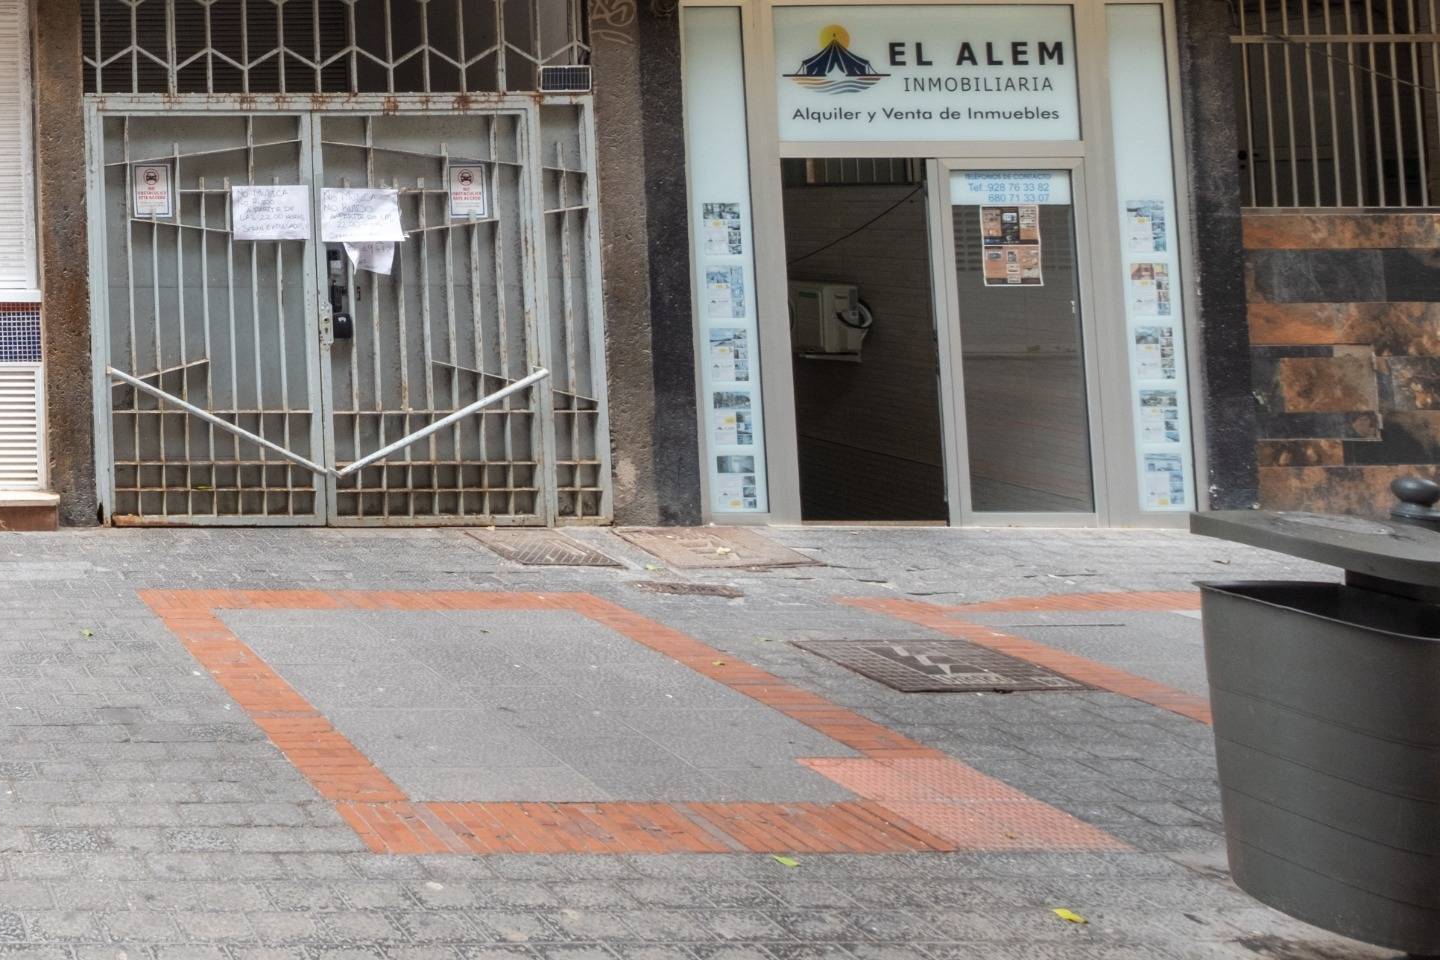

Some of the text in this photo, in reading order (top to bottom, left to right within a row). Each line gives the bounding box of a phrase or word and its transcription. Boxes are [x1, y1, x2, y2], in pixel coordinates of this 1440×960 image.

[889, 41, 1064, 66] EL ALEM
[903, 77, 1054, 92] INMOBILIARIA
[792, 106, 1061, 123] Alquiler y Venta de Inmuebles
